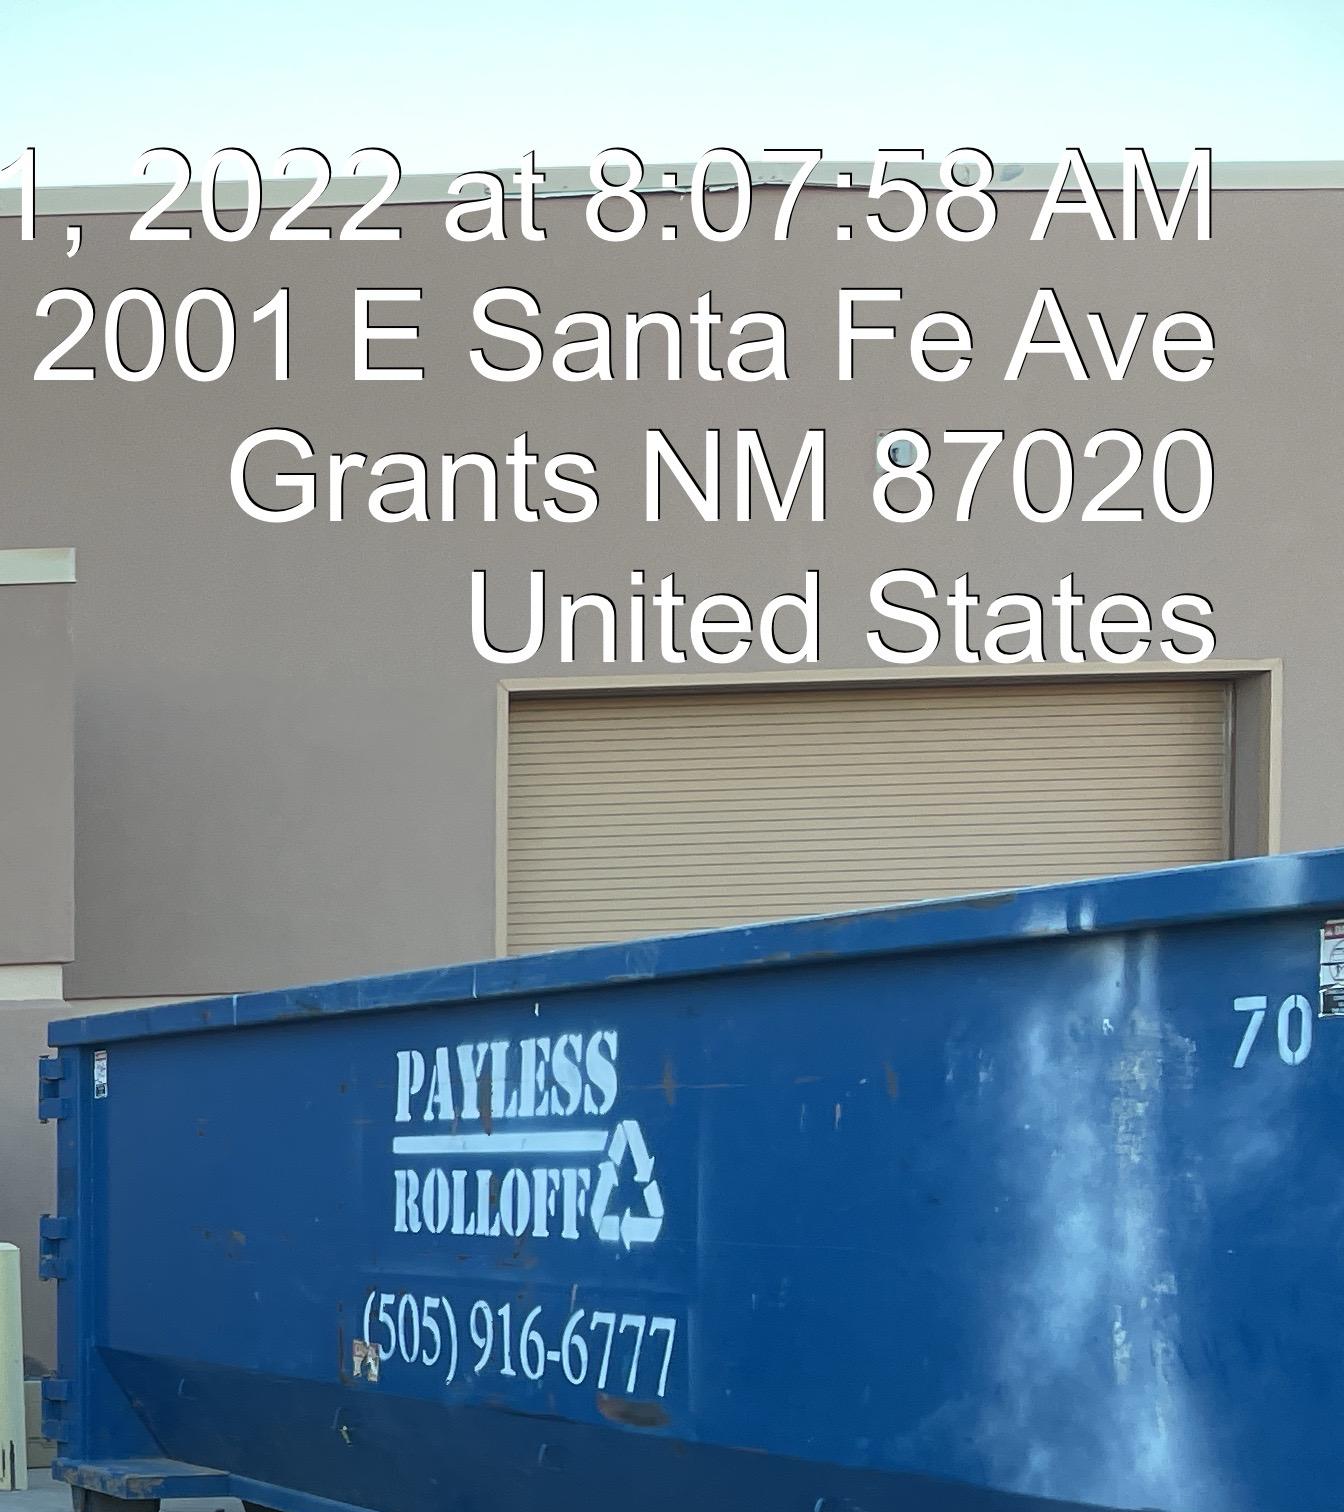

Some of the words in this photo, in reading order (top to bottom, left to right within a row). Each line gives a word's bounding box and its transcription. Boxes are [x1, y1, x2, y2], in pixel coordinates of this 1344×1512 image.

[1233, 994, 1311, 1069] 70
[395, 1030, 619, 1122] PAYLESS
[393, 1167, 591, 1240] ROLLOFF
[363, 1290, 458, 1386] (505)
[470, 1300, 677, 1398] 916-6777
